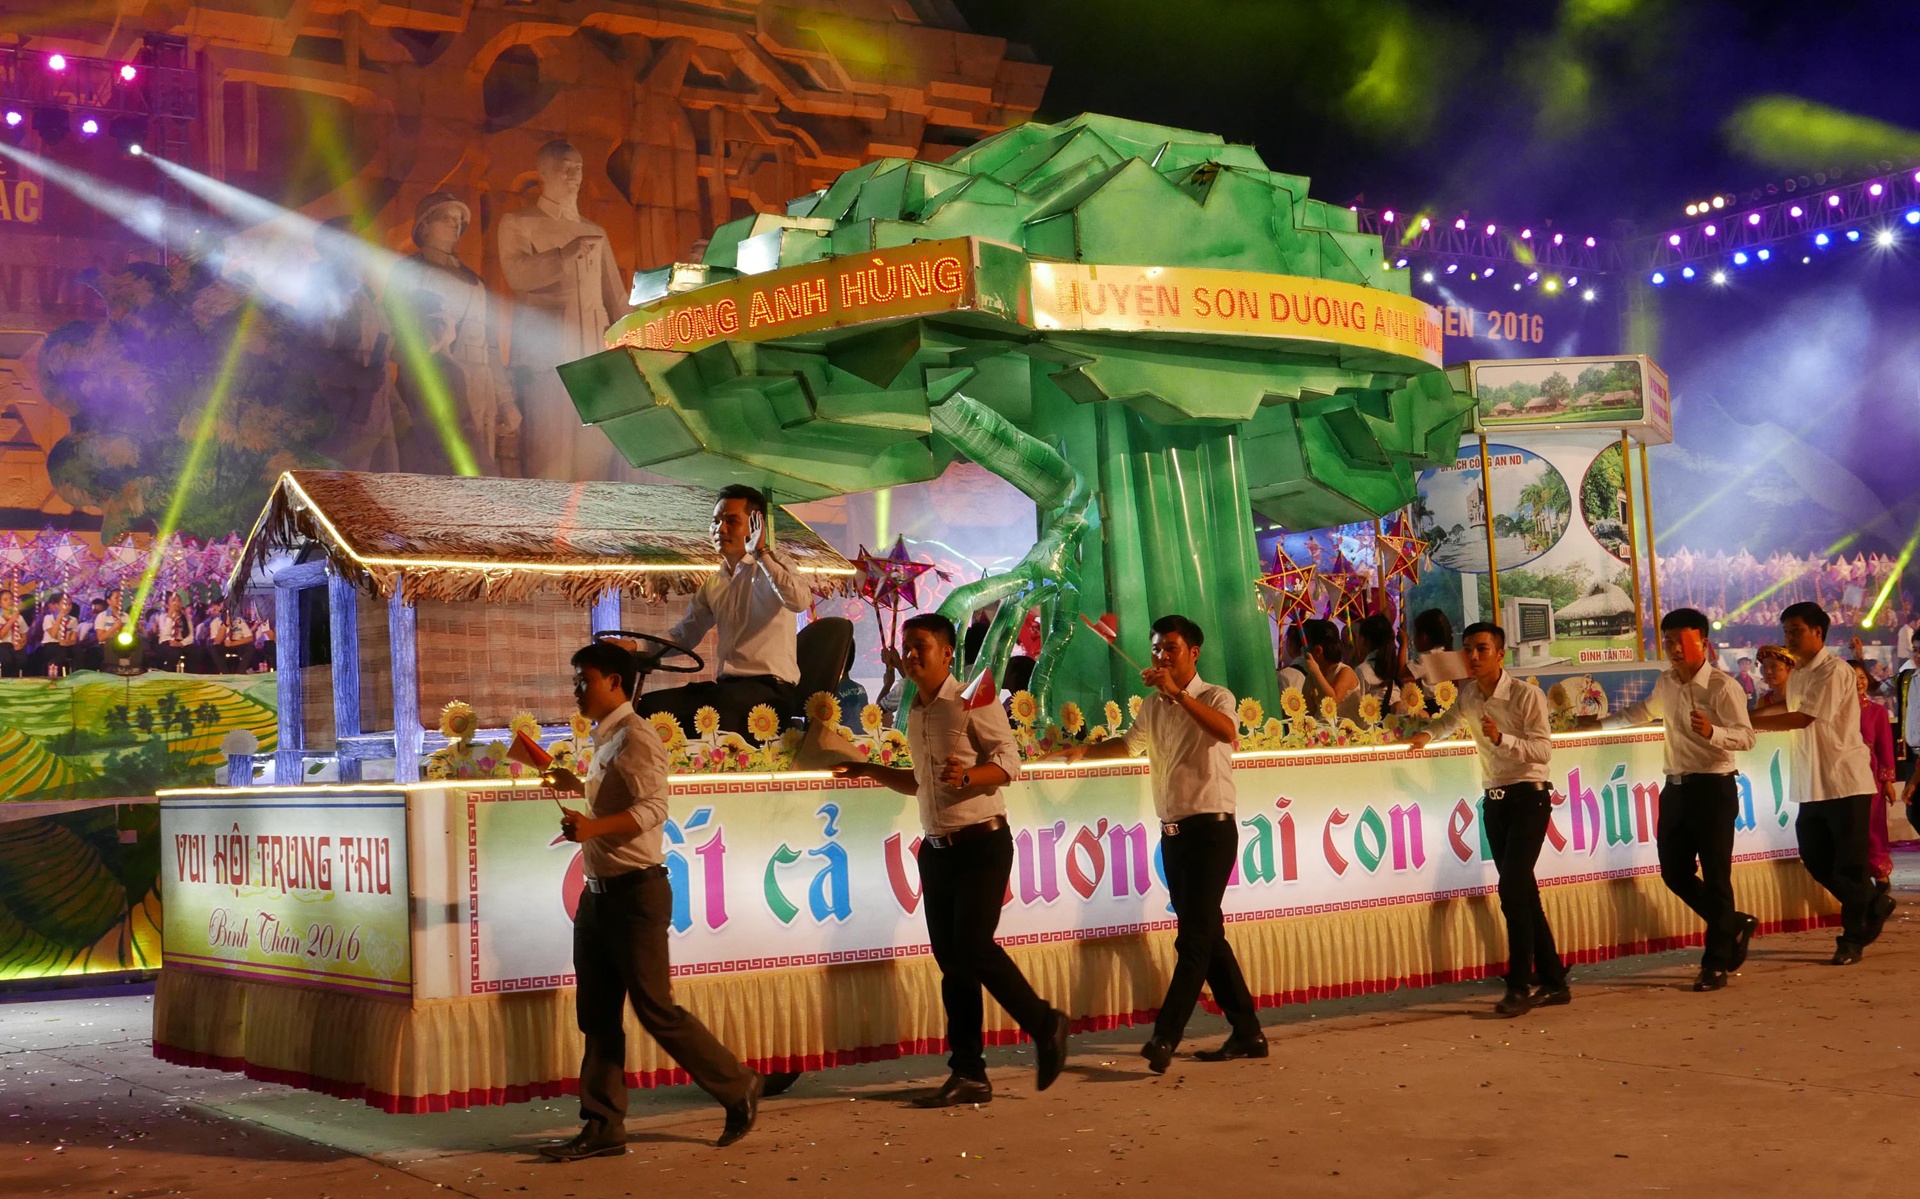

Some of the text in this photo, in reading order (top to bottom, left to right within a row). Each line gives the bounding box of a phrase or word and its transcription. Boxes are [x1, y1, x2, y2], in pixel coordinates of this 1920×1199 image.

[749, 278, 828, 328] ANH
[841, 257, 964, 309] HÙNG
[1373, 304, 1410, 343] ANH
[1436, 299, 1544, 343] ÊN 2016
[1469, 456, 1493, 469] CÔG
[1494, 456, 1507, 467] AN
[1509, 454, 1522, 465] ND
[174, 822, 392, 898] VUI HỘI TRUNG THU
[764, 803, 853, 925] cả
[1227, 797, 1299, 886] ai
[1323, 802, 1426, 877] con
[1546, 764, 1663, 858] chún
[208, 907, 249, 949] Bính
[306, 923, 361, 961] 2016
